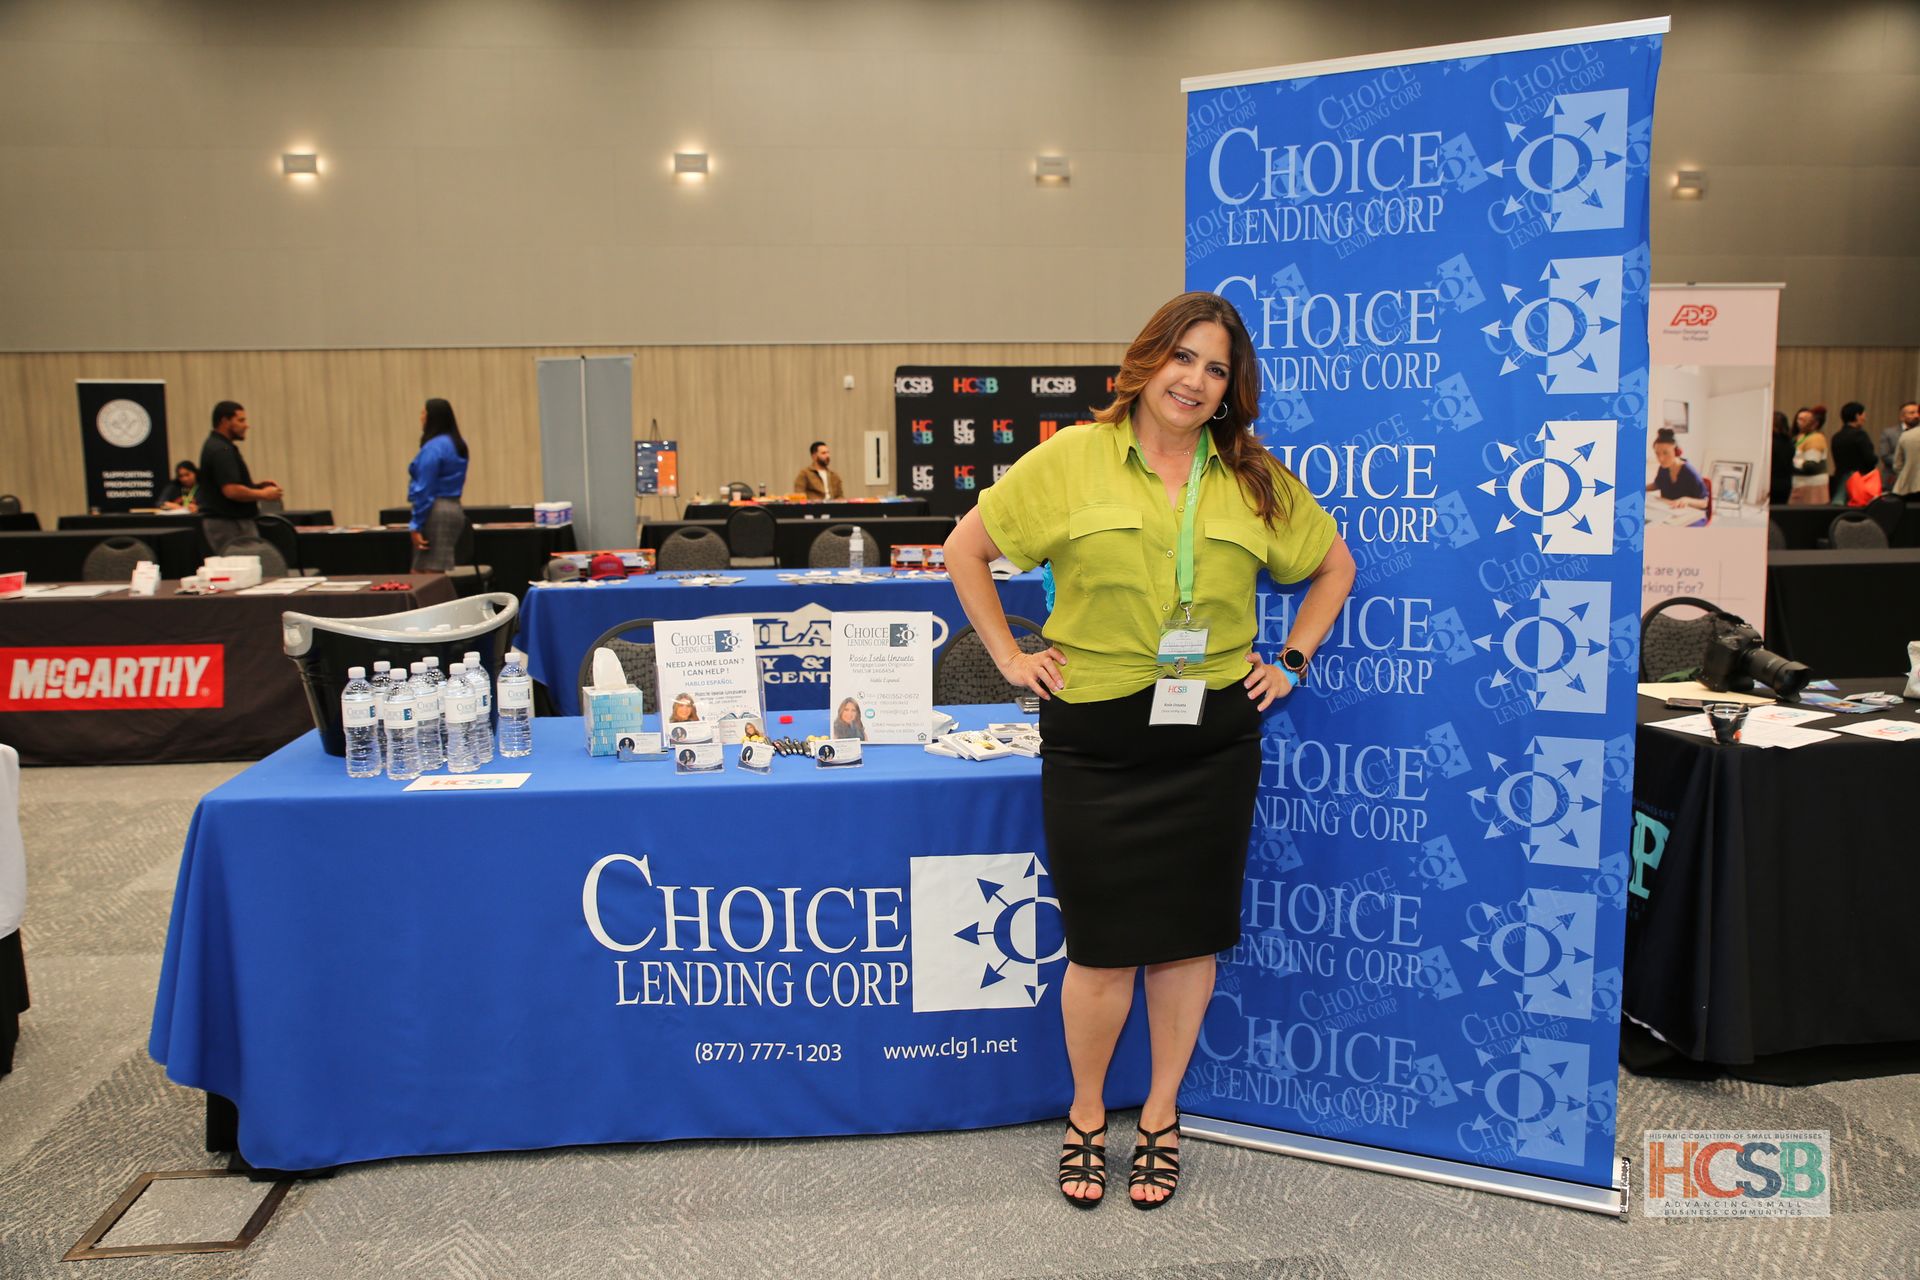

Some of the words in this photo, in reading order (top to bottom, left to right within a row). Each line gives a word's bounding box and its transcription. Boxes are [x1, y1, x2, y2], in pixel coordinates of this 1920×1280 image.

[1187, 86, 1251, 139] HOICE
[1187, 120, 1228, 158] ENDING
[1209, 125, 1444, 206] CHOICE
[1227, 201, 1353, 247] LENDING
[1364, 195, 1444, 237] CORP
[1671, 304, 1717, 326] ADP
[953, 376, 999, 393] HCSB
[1031, 376, 1076, 394] HCSB
[1259, 355, 1352, 392] NDING
[1362, 352, 1440, 391] CORP
[1264, 444, 1438, 500] OICE
[1358, 505, 1438, 543] CORP
[1479, 551, 1577, 593] CHOIC
[1643, 581, 1674, 596] rking
[1677, 581, 1704, 593] For?
[1654, 567, 1674, 576] are
[1676, 567, 1700, 580] you
[671, 631, 714, 647] CHOICE
[844, 623, 888, 639] CHOICE
[847, 639, 873, 647] LENDING
[874, 639, 889, 647] CORP
[666, 661, 686, 669] NEED
[695, 659, 717, 667] HOME
[719, 658, 739, 666] LOAN
[675, 646, 698, 655] LENDING
[849, 653, 867, 662] Rosie
[869, 653, 886, 662] Isela
[764, 671, 831, 684] CENT
[1167, 685, 1188, 693] HCSB
[1355, 656, 1433, 695] CORP
[1258, 738, 1430, 801] HOICE
[1253, 795, 1340, 836] NDING
[1351, 803, 1428, 844] CORP
[582, 853, 908, 954] CHOICE
[1244, 877, 1423, 947] HOICE
[614, 960, 796, 1008] LENDING
[805, 960, 909, 1008] CORP
[1346, 947, 1421, 988] CORP
[694, 1041, 745, 1065] (877)
[750, 1042, 842, 1064] 777-1203
[883, 1036, 1018, 1061] www.clg1.net
[1198, 990, 1417, 1090] CHOICE
[1211, 1064, 1331, 1115] LENDING
[1342, 1086, 1416, 1129] CORP
